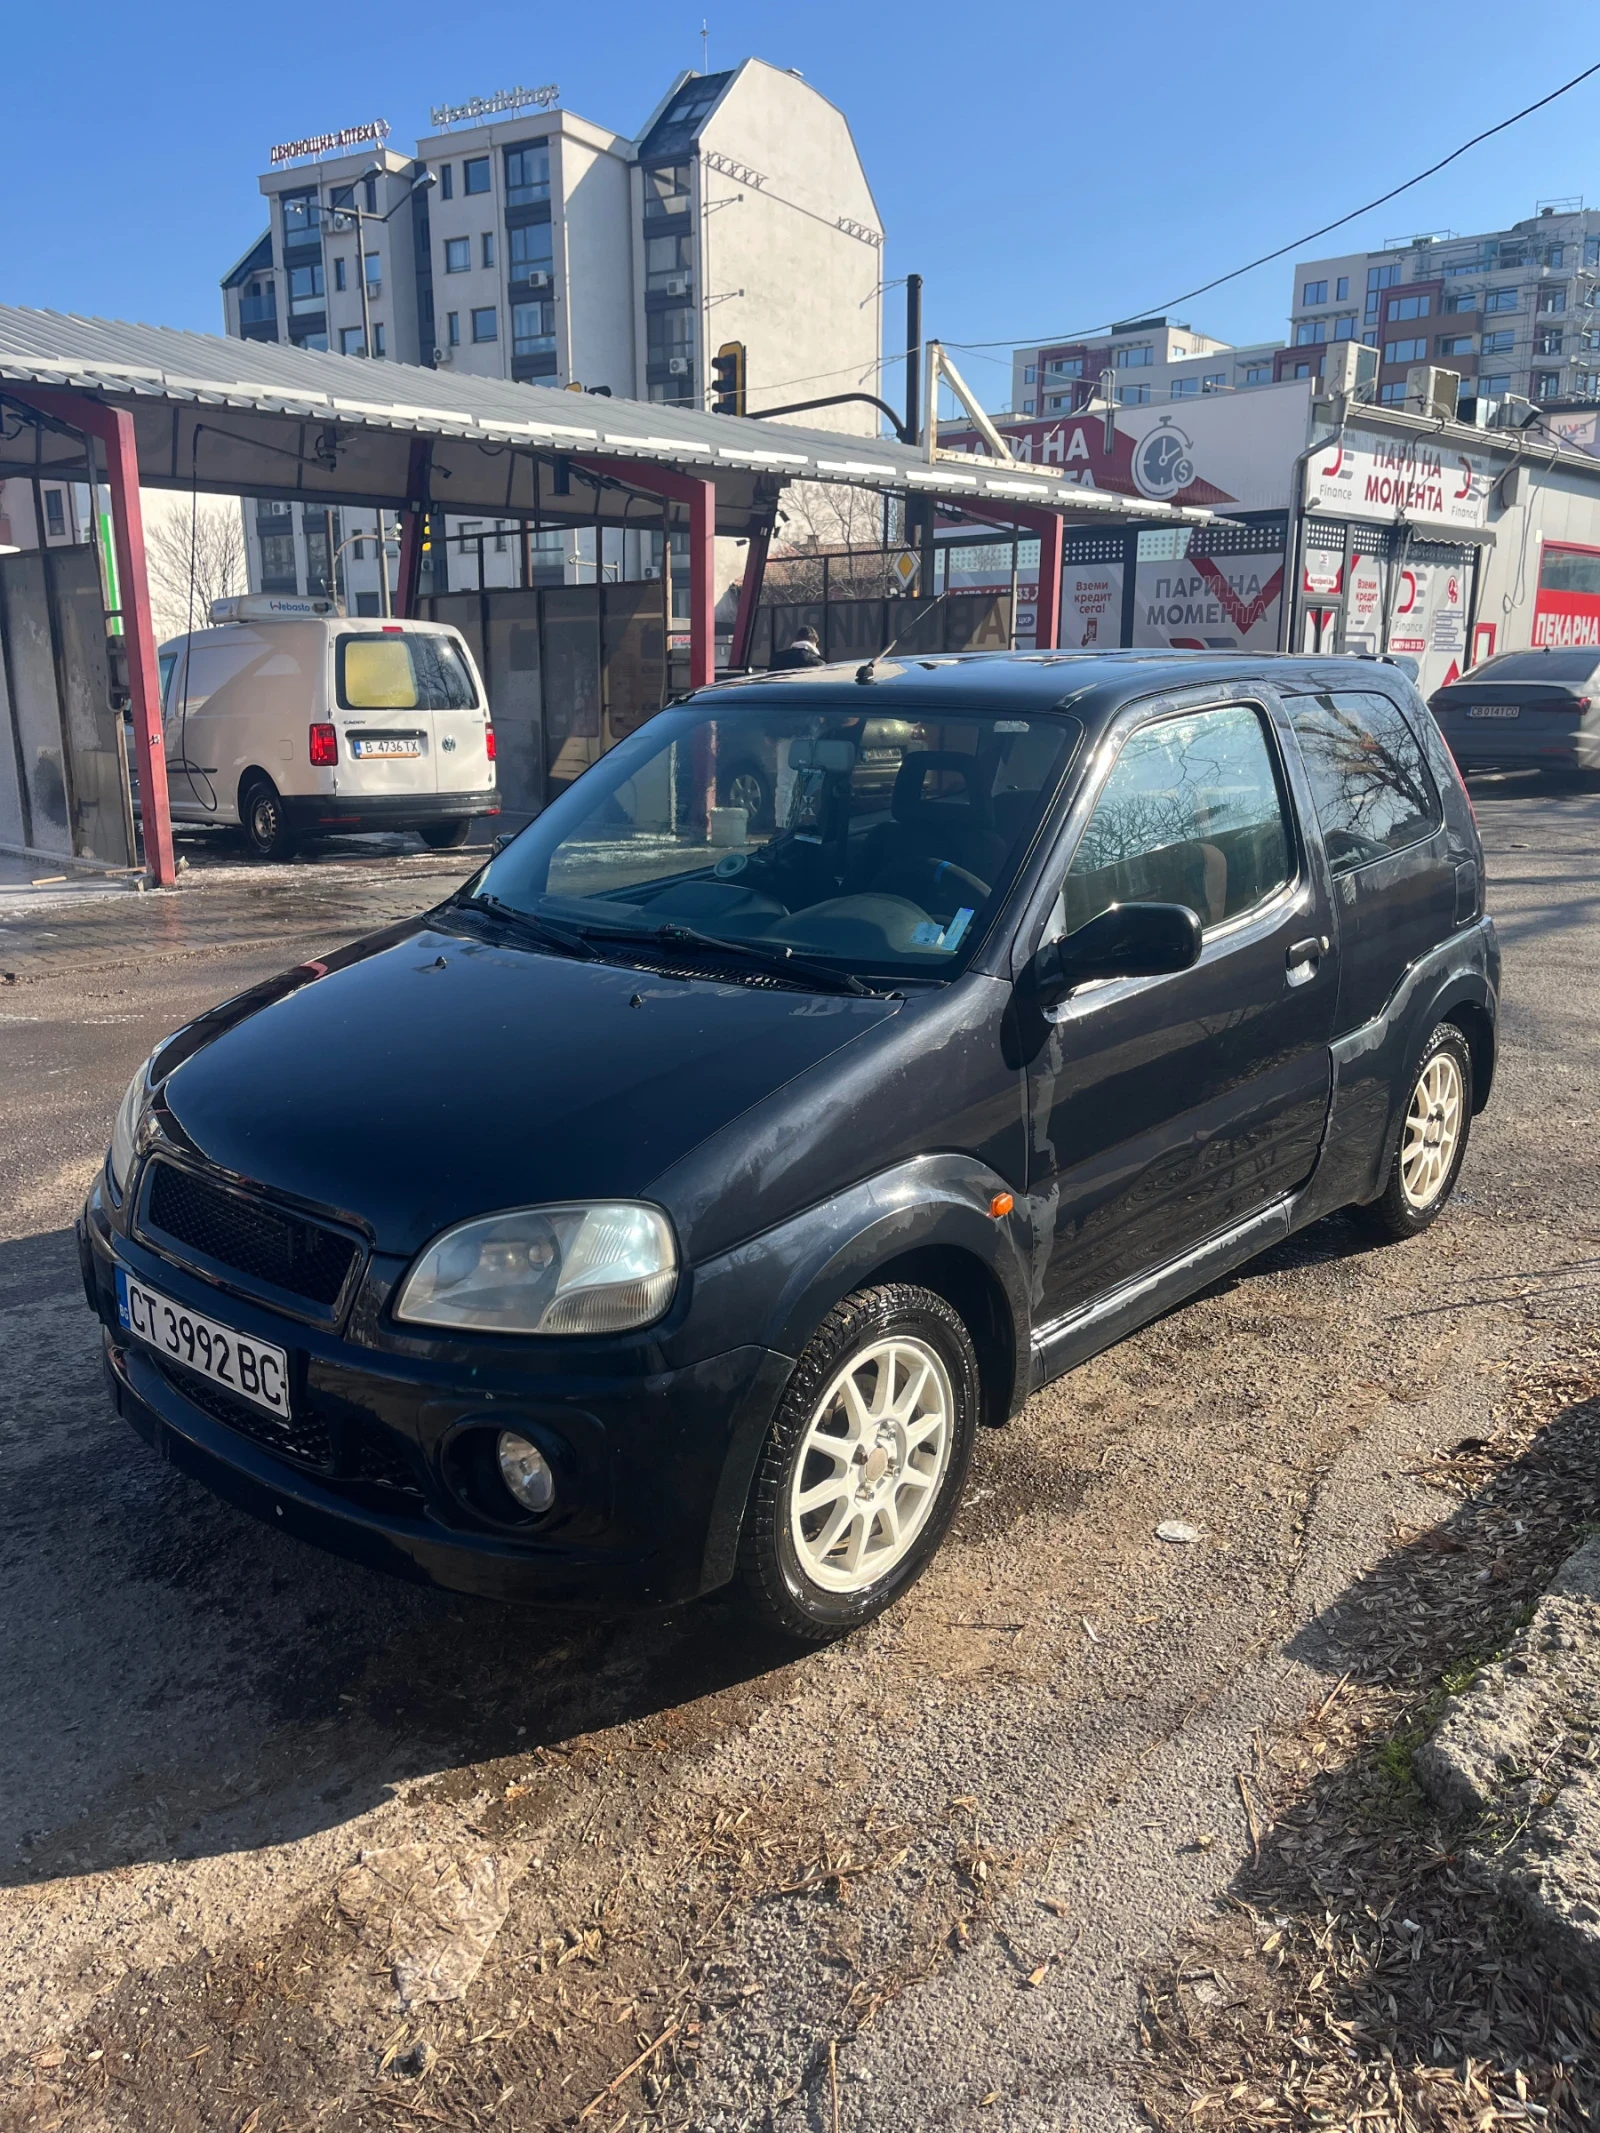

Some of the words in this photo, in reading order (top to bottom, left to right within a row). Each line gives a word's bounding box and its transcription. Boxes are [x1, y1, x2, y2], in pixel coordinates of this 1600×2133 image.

[430, 84, 560, 126] IdeaBuildings
[1043, 427, 1090, 463] НА
[1373, 440, 1416, 473] ПАРИ
[1421, 449, 1442, 479] НА
[1319, 484, 1352, 500] Finance
[1364, 474, 1443, 512] МОМЕНТА
[1451, 505, 1478, 520] Finance
[1076, 581, 1109, 591] Вземи
[1155, 574, 1221, 599] ПАРИ
[1227, 573, 1264, 597] НА
[1357, 578, 1377, 590] Вземи
[1074, 592, 1113, 604] кредит
[1355, 592, 1378, 603] кредит
[269, 601, 311, 612] Webasto
[1079, 603, 1106, 615] сега!
[1146, 600, 1268, 626] МОМЕНТА
[1394, 621, 1424, 632] Finance
[1535, 613, 1599, 645] ПЕКАРНА
[378, 741, 403, 753] 4736
[405, 741, 418, 752] TX
[119, 1303, 129, 1321] BG
[130, 1285, 157, 1342] CT
[164, 1306, 235, 1385] 3992
[237, 1341, 281, 1406] BC
